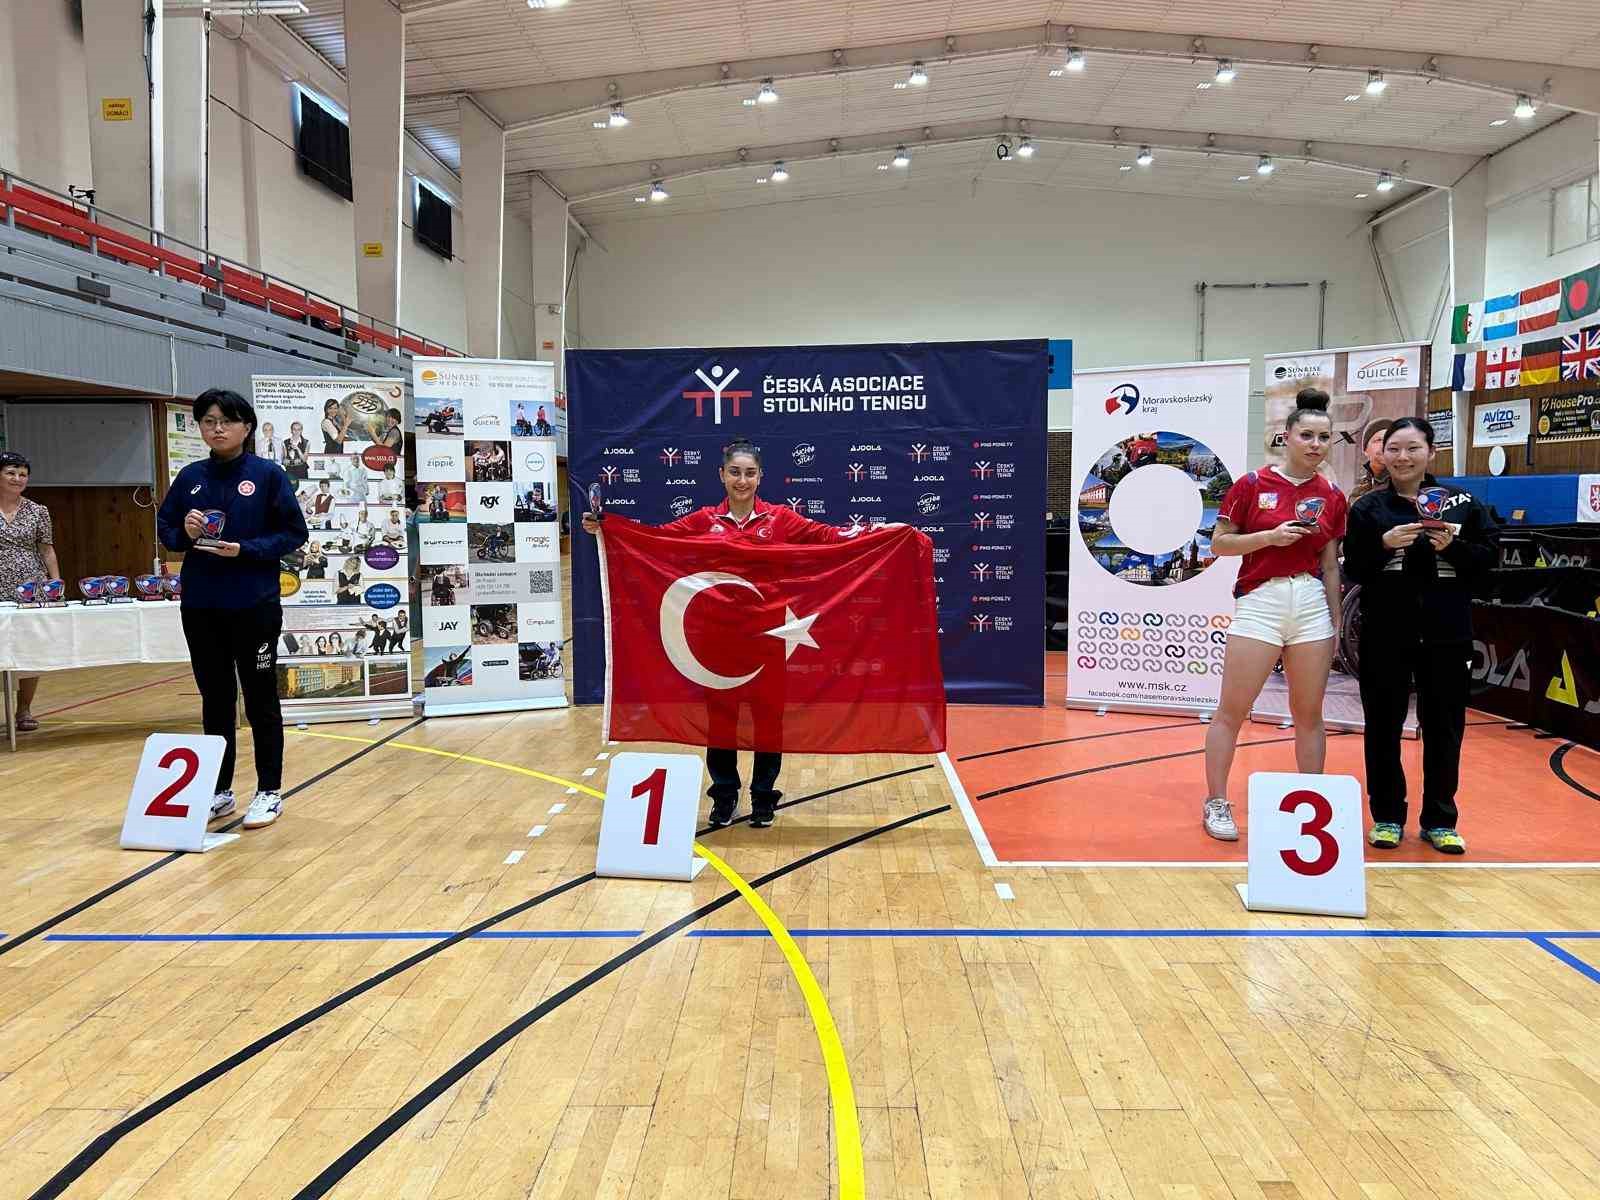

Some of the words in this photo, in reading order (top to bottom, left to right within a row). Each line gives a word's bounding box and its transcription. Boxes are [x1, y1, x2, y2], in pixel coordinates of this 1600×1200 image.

[1287, 365, 1321, 373] SUNRISE
[1357, 367, 1408, 379] QUICKIE
[763, 374, 824, 394] ČESKÁ
[830, 375, 924, 392] ASOCIACE
[763, 393, 854, 413] STOLNÍHO
[860, 394, 927, 411] TENISU
[1142, 394, 1213, 405] Moravskoslezský
[1142, 405, 1158, 414] kraj
[525, 536, 550, 544] magic
[438, 621, 459, 631] JAY
[256, 653, 271, 661] TEAM
[1118, 680, 1187, 692] www.msk.cz
[1088, 689, 1218, 704] facebook.com/nasemoravskoslezsko
[144, 748, 200, 817] 2
[631, 768, 668, 845] 1
[1279, 790, 1340, 876] 3
